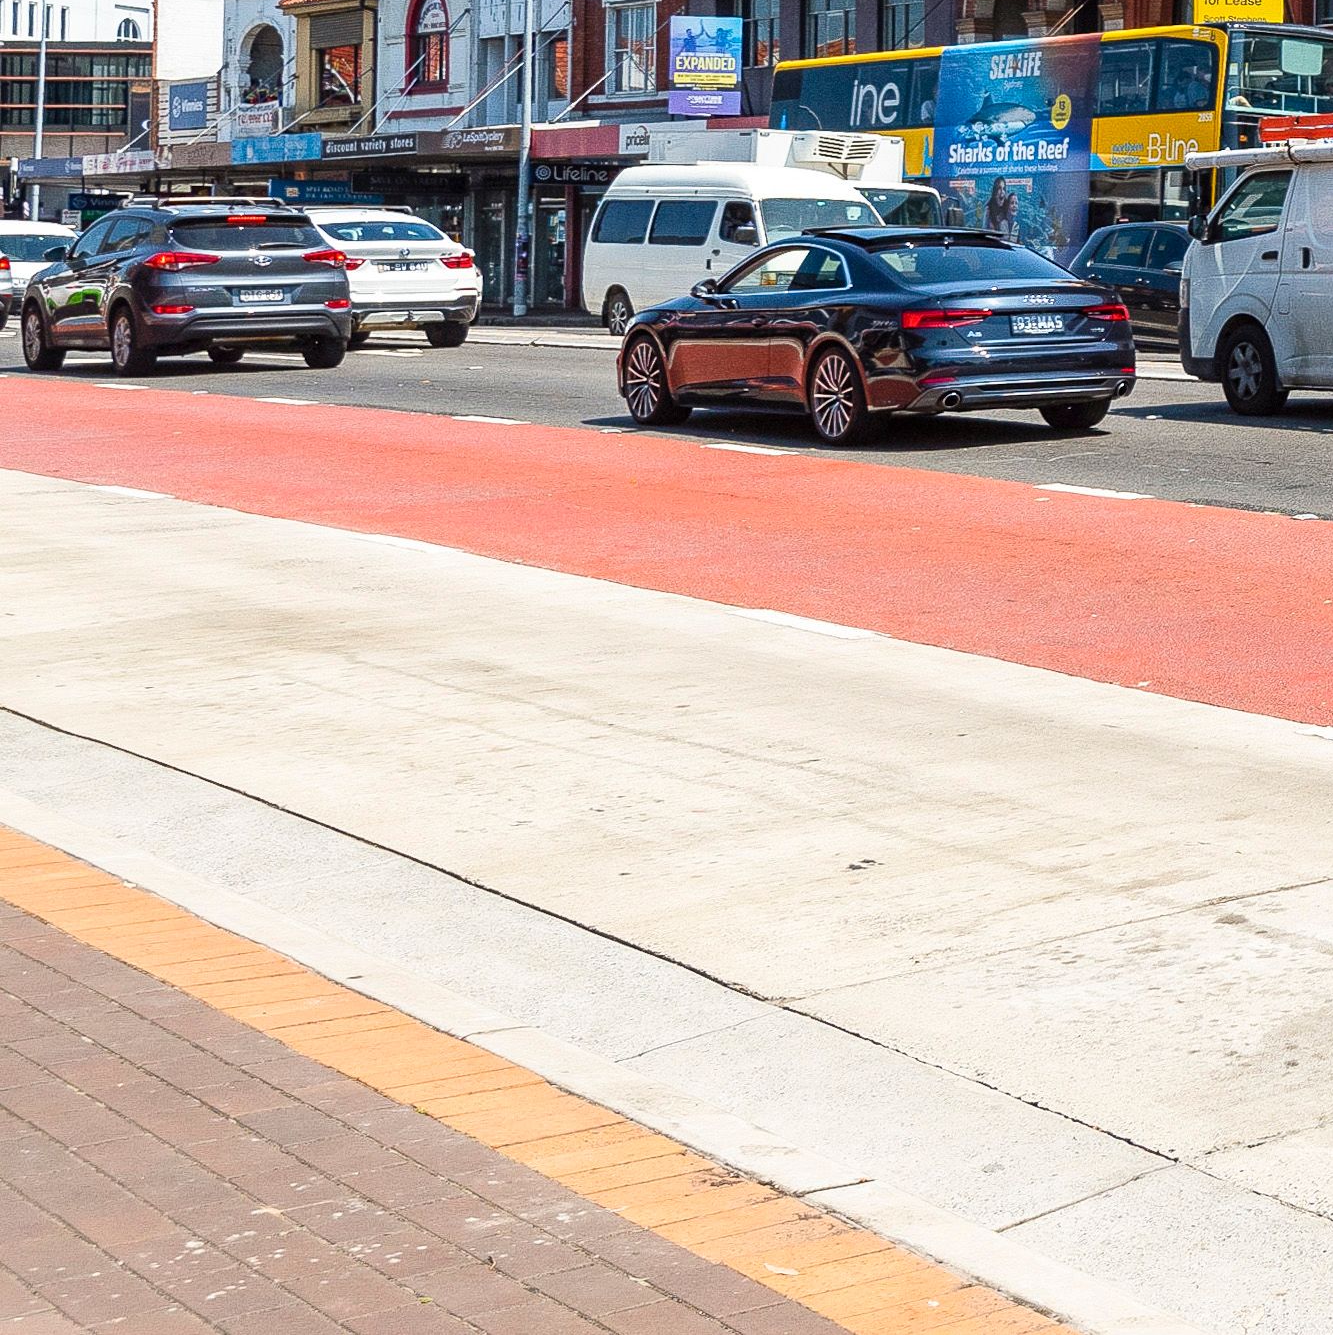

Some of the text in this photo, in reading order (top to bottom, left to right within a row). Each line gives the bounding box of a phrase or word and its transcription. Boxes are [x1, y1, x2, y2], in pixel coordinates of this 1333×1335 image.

[675, 56, 736, 71] EXPANDED
[850, 80, 900, 126] ine
[326, 140, 358, 154] discount
[361, 138, 387, 153] variety
[390, 137, 414, 149] stores
[949, 137, 1070, 164] Sharks of the Reef
[553, 166, 608, 183] Lifeline
